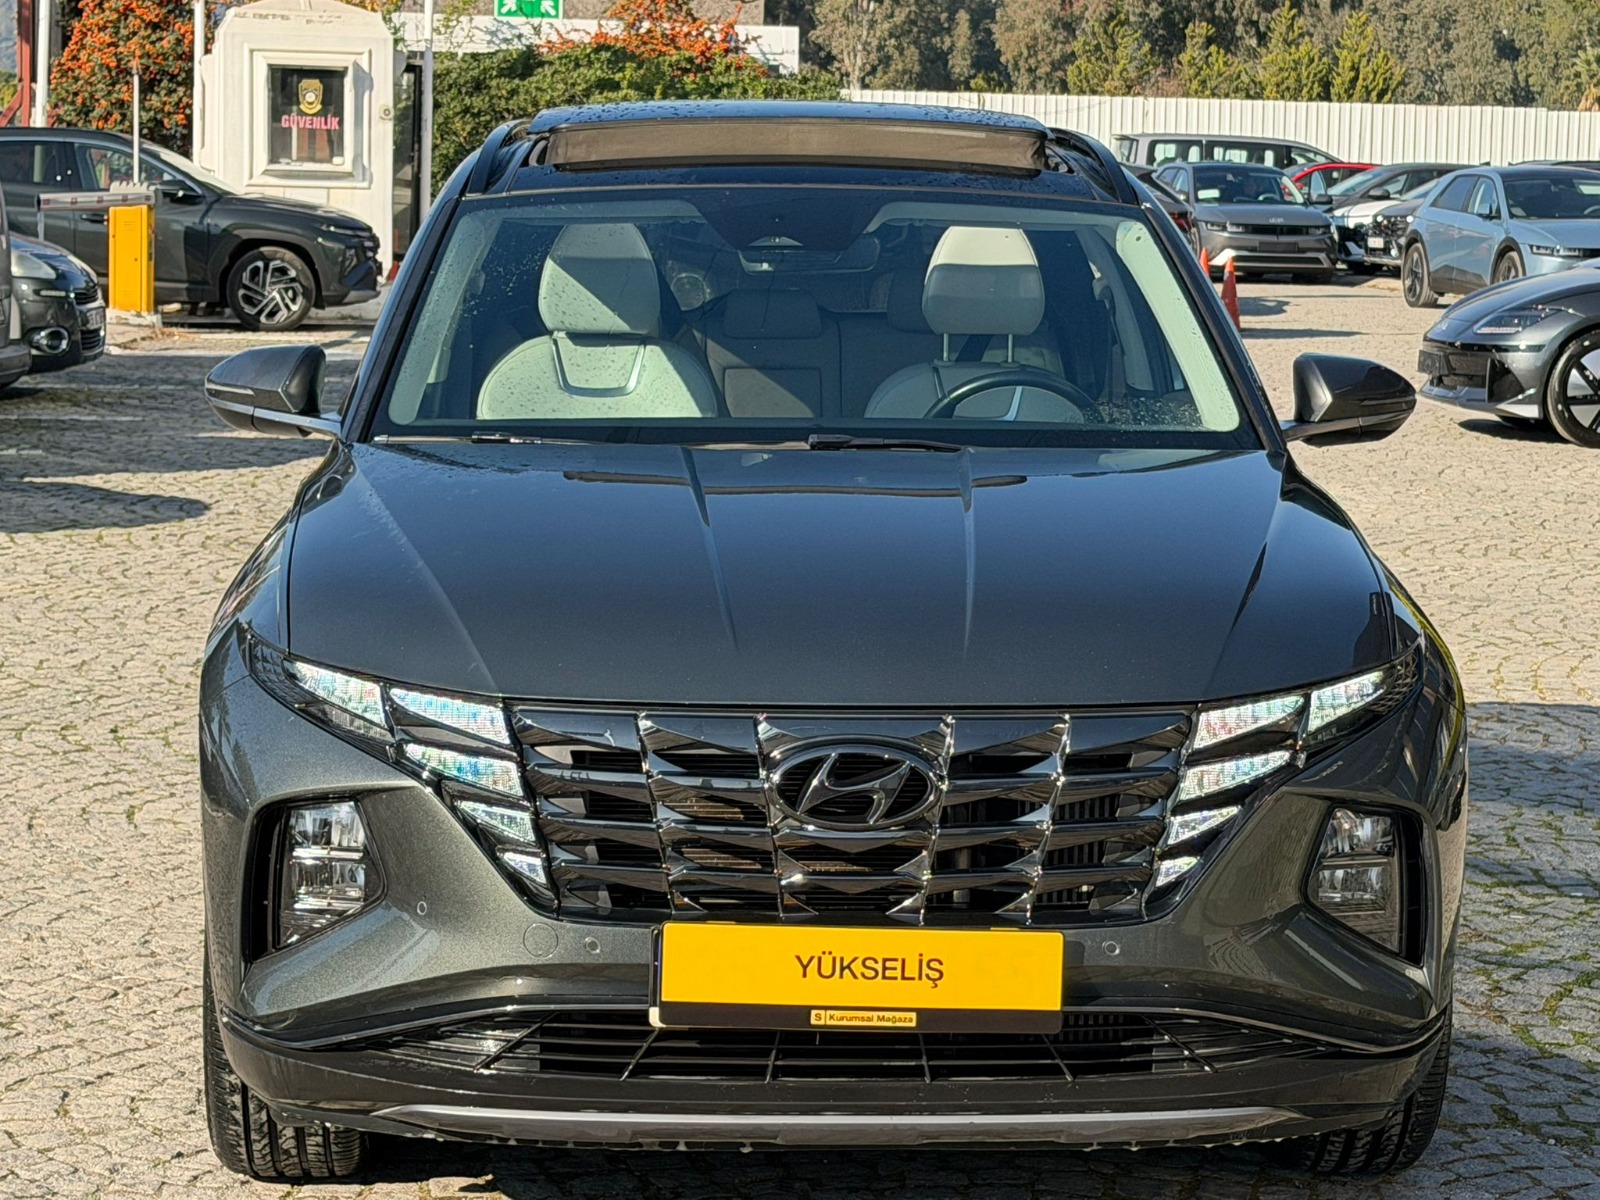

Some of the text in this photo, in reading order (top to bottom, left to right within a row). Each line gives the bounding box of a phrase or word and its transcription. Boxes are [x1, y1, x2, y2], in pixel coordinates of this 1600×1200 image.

[281, 113, 339, 130] GÜVENLİK
[795, 951, 944, 989] YÜKSELİŞ
[814, 1013, 913, 1025] S Kurumsal Mağaza
